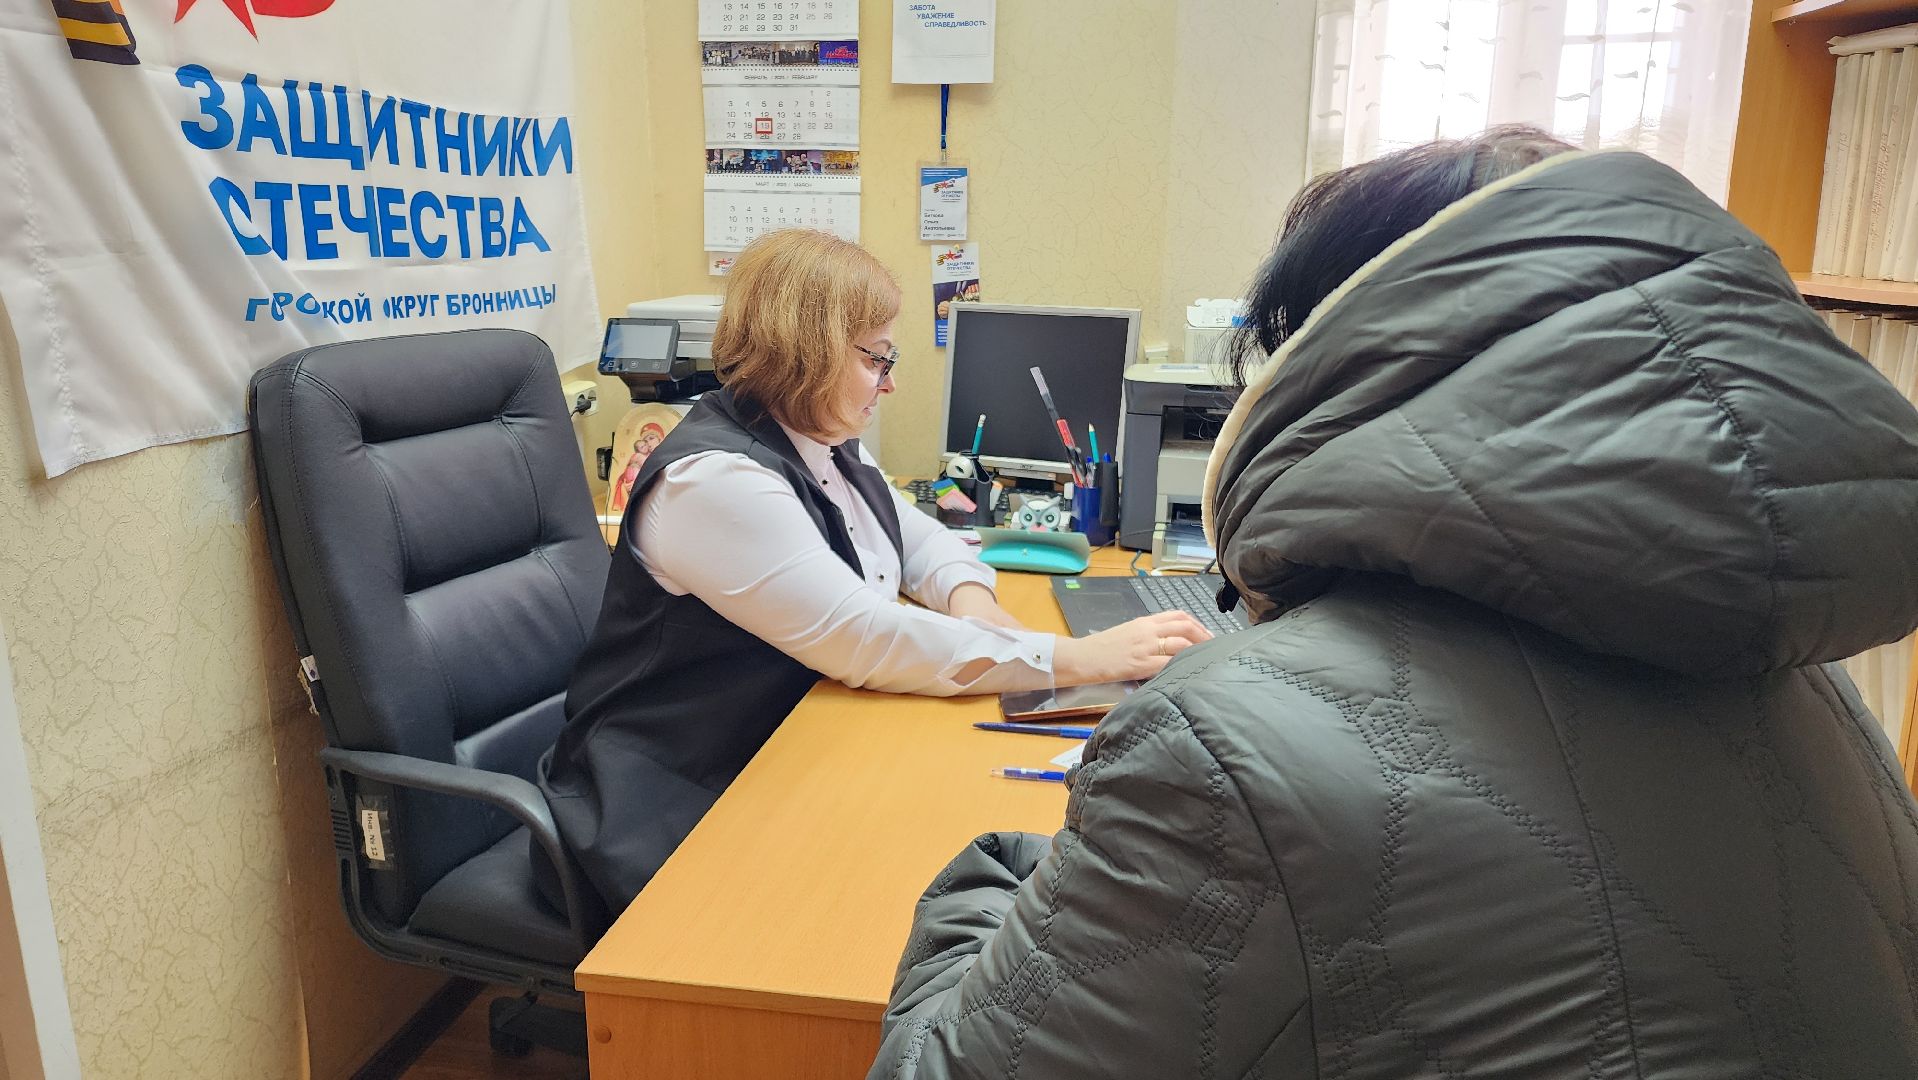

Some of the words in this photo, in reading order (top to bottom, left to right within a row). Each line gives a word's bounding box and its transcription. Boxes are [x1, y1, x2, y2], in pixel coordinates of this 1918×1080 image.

[723, 3, 732, 11] 13
[790, 2, 799, 10] 17
[916, 12, 955, 20] УВАЖЕНИЕ
[756, 24, 765, 32] 29
[924, 20, 988, 28] СПРАВЕДЛИВОСТЬ
[175, 63, 573, 177] ЗАЩИТНИКИ
[446, 284, 557, 315] БРОННИЦЫ
